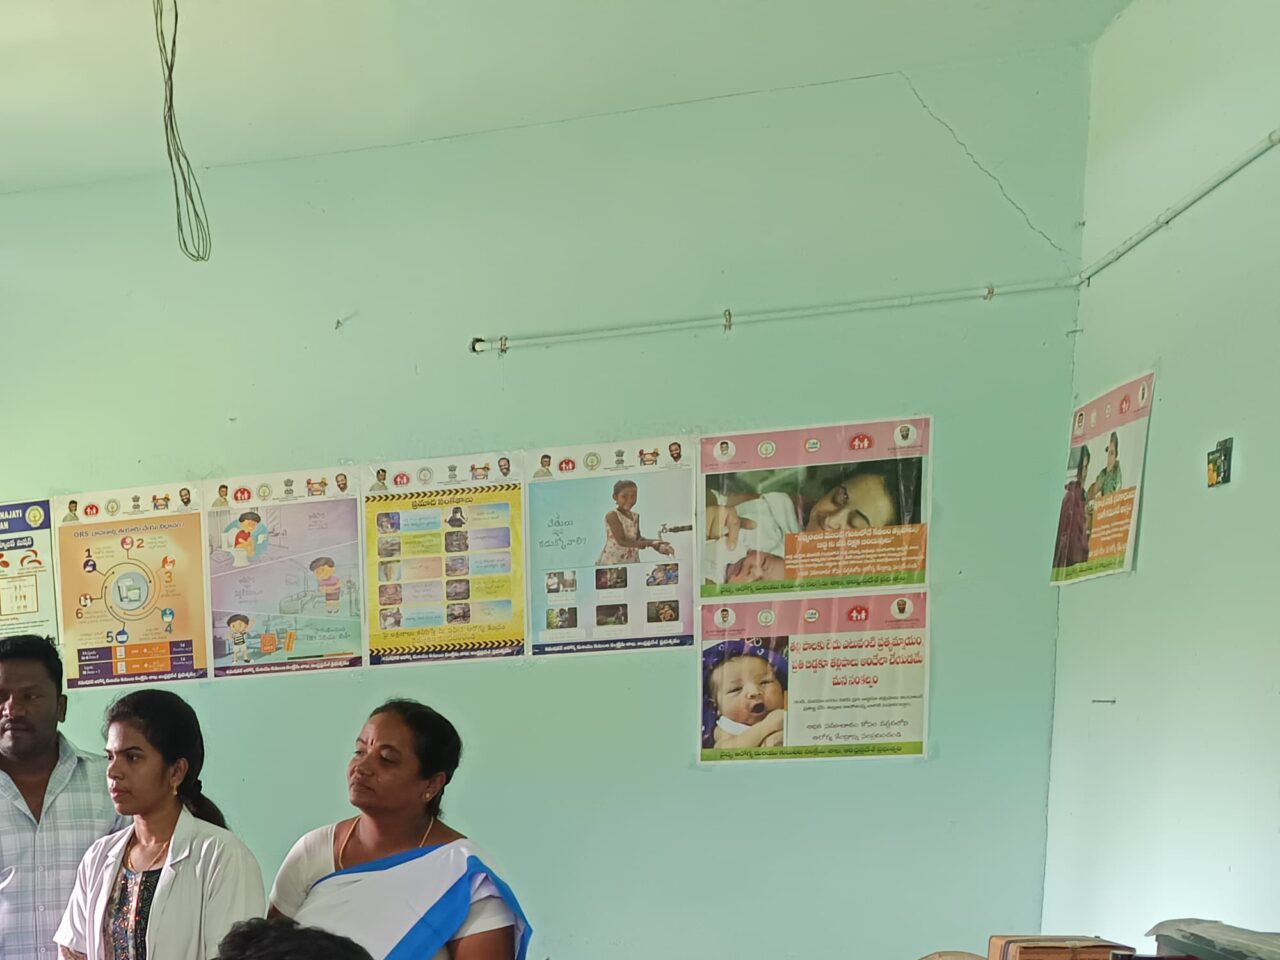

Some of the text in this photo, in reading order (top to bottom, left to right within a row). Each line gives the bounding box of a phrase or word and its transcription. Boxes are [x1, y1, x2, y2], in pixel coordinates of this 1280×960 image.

[74, 530, 89, 539] ORS
[136, 538, 145, 549] 2
[85, 548, 92, 559] 1
[165, 571, 173, 584] 3
[75, 608, 83, 620] 6
[164, 623, 173, 635] 4
[106, 631, 114, 643] 5
